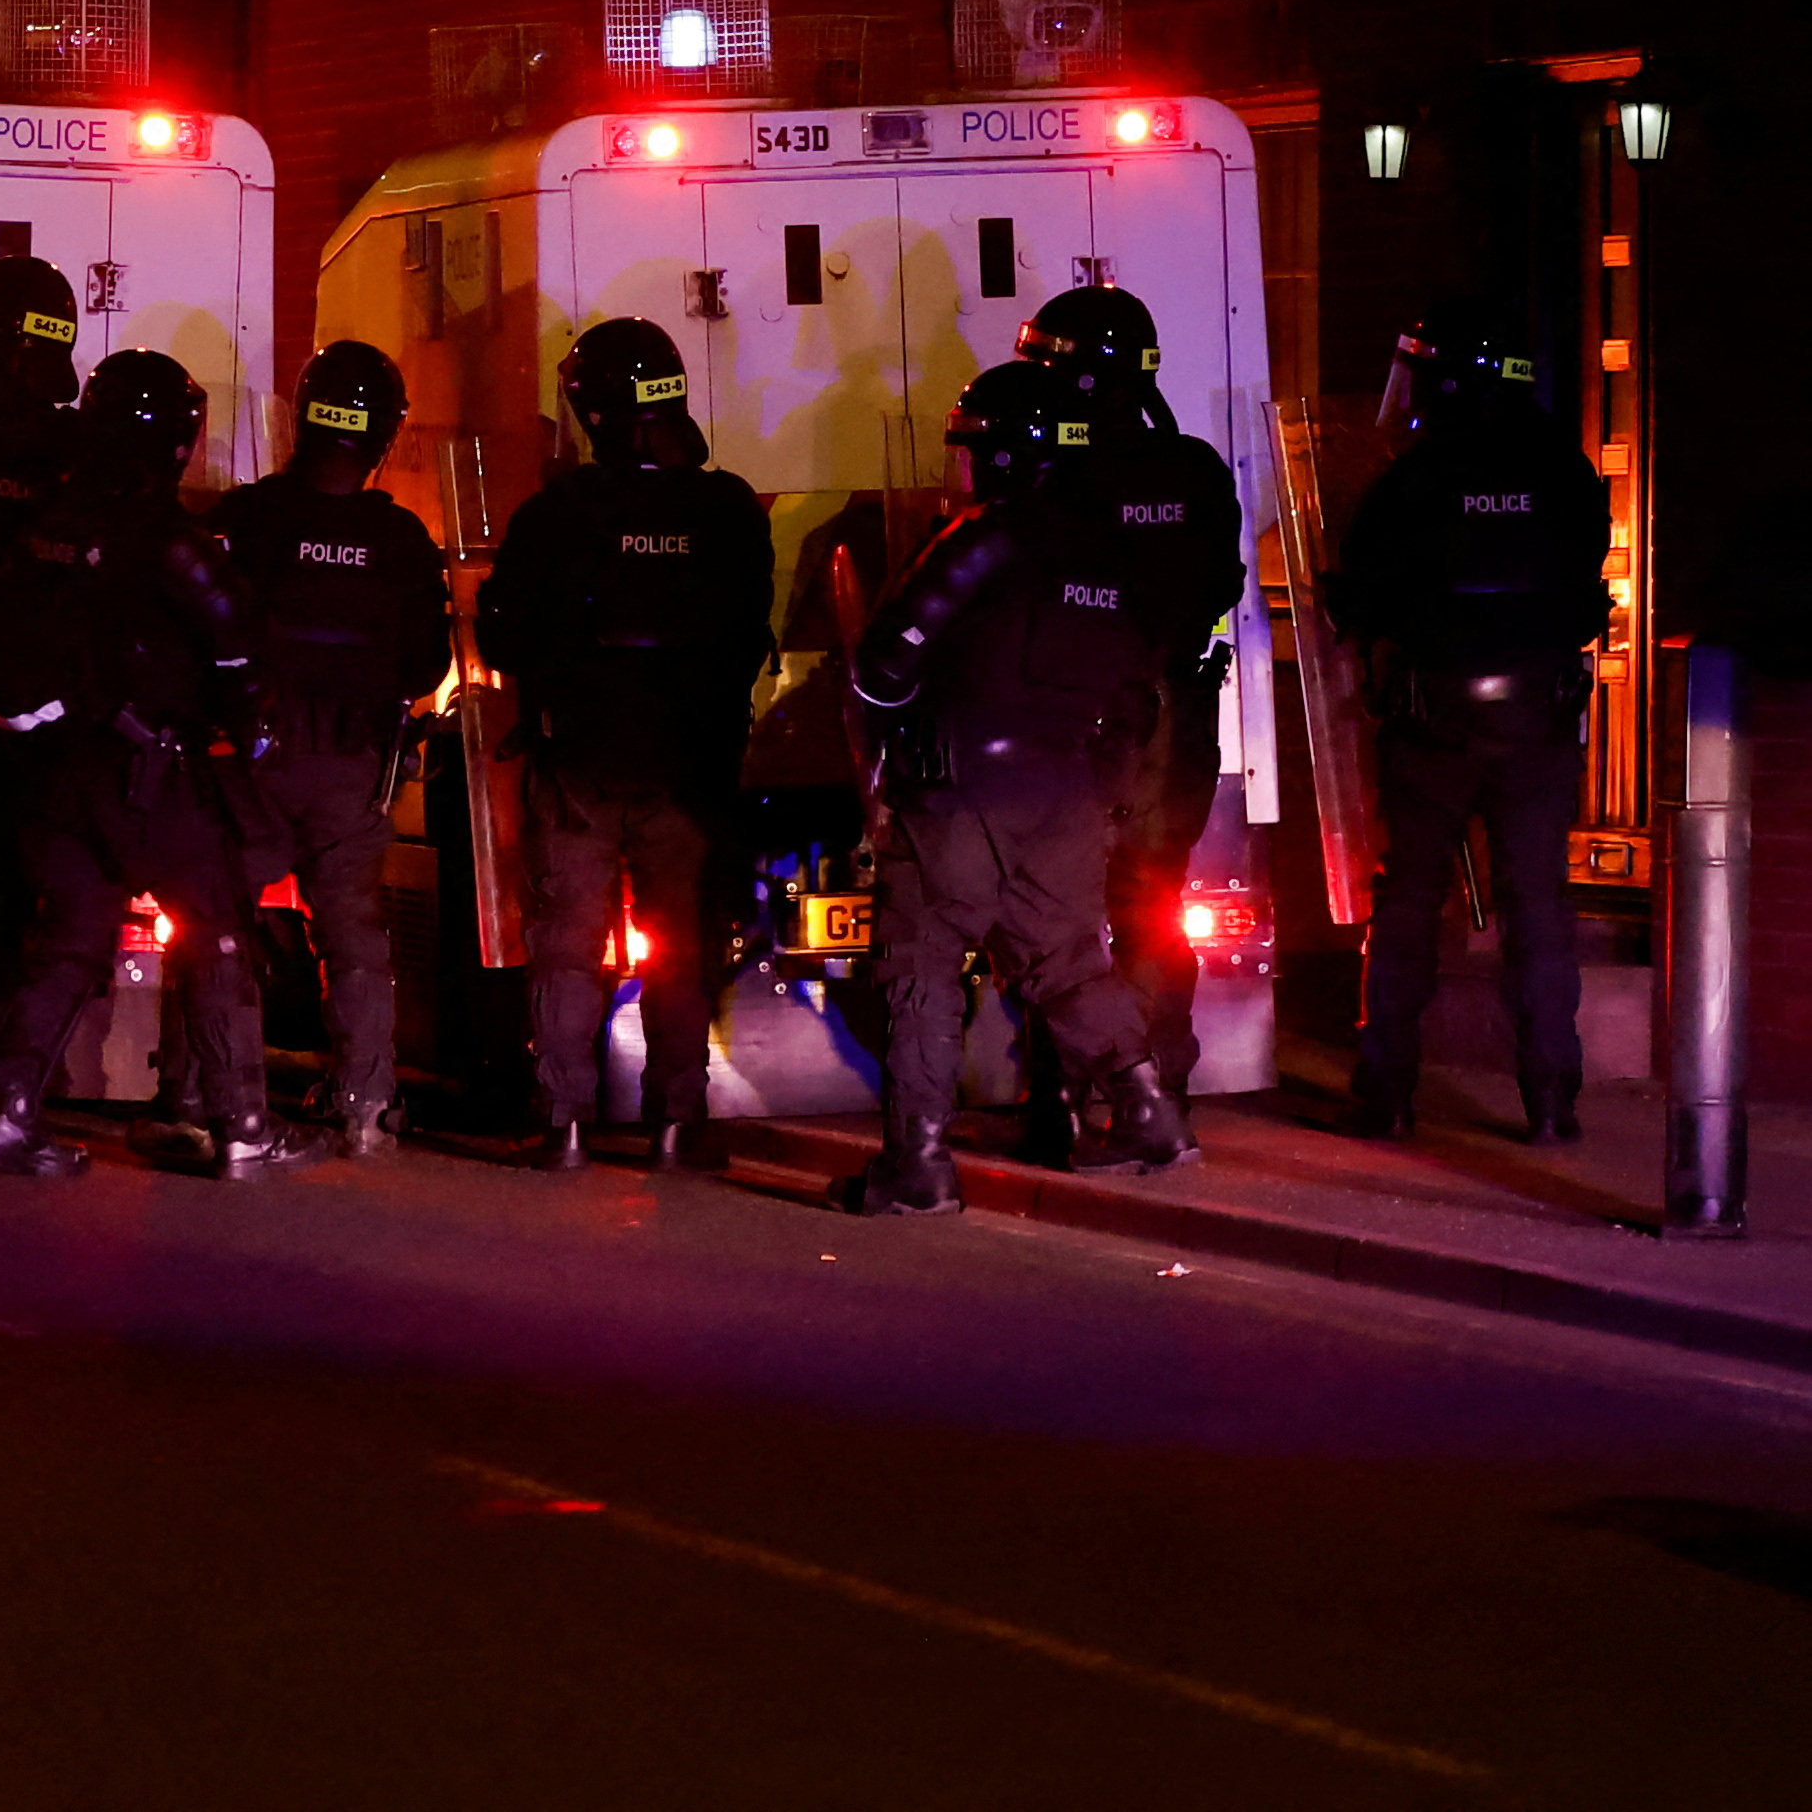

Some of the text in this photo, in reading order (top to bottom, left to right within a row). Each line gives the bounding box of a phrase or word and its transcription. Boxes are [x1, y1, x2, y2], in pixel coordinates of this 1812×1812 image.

[963, 108, 1080, 142] POLICE
[757, 125, 829, 152] S43D
[33, 318, 70, 337] S43-C
[315, 408, 359, 425] S43-C
[1122, 504, 1184, 523] POLICE
[1463, 494, 1533, 515] POLICE
[299, 542, 368, 566] POLICE
[622, 535, 690, 554] POLICE
[1064, 583, 1118, 610] POLICE
[826, 904, 873, 940] GF
